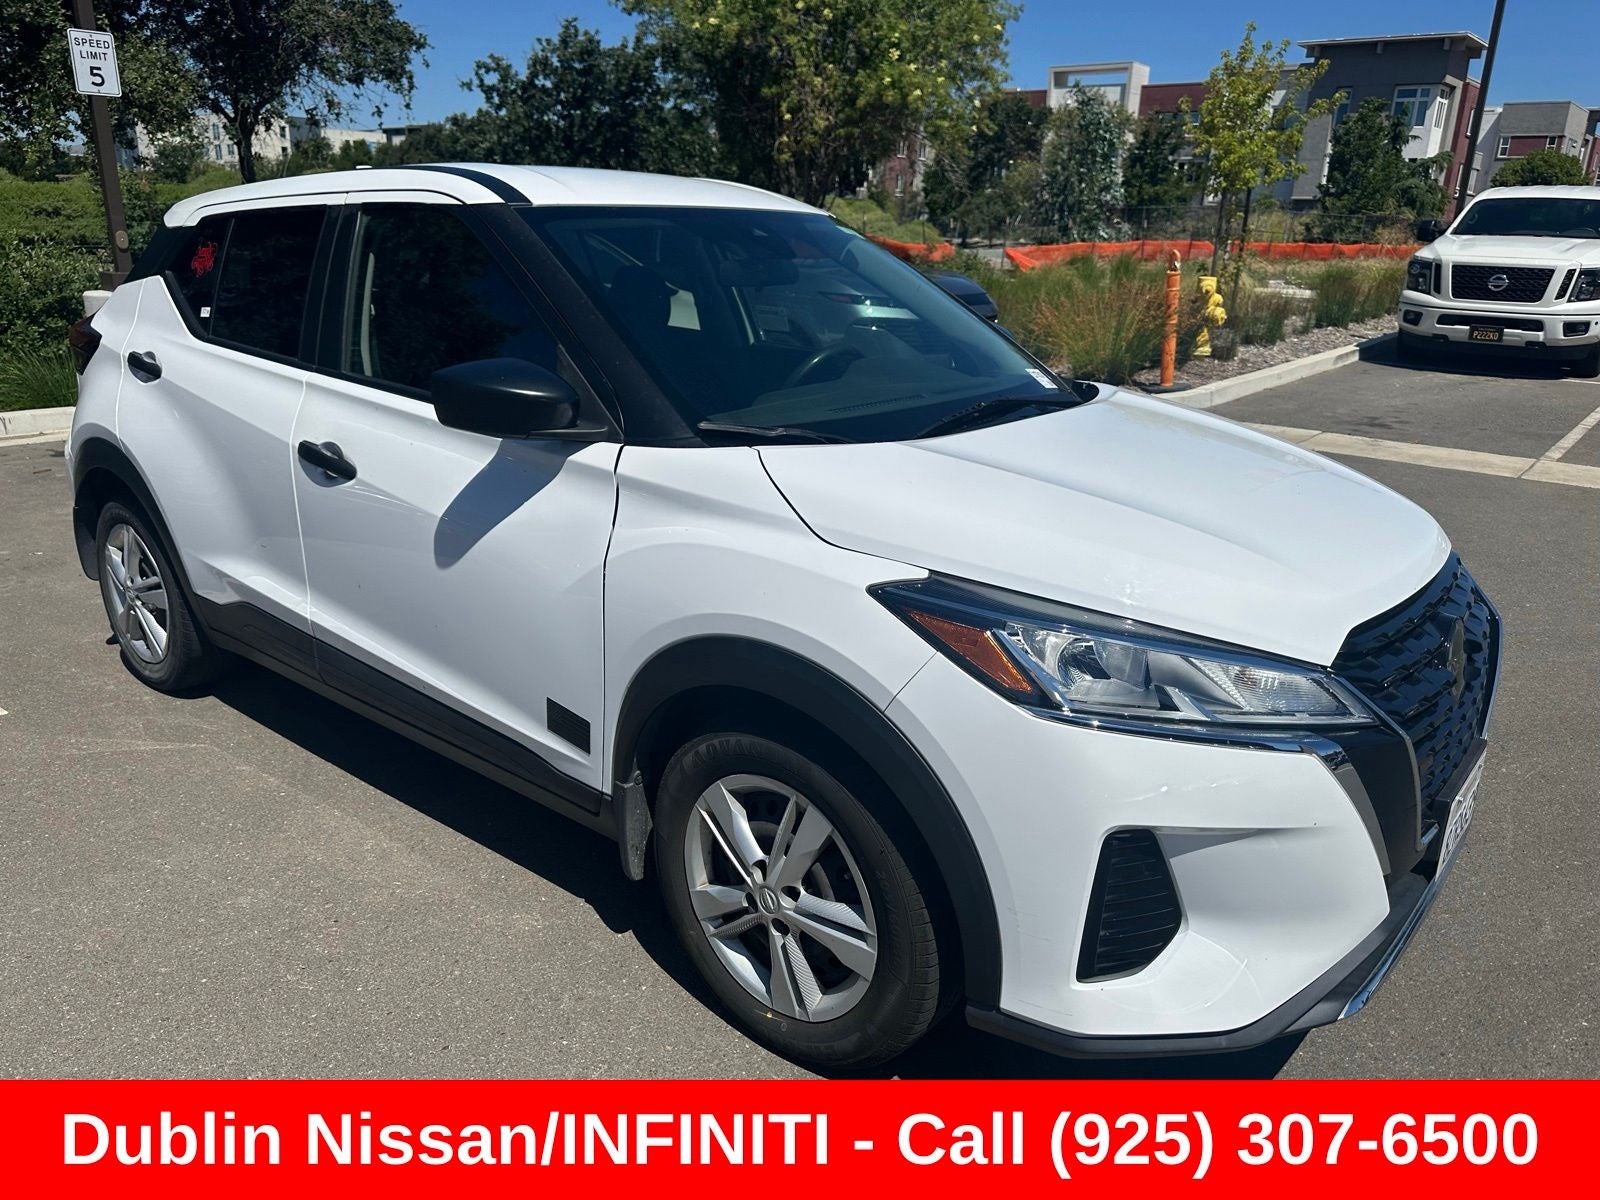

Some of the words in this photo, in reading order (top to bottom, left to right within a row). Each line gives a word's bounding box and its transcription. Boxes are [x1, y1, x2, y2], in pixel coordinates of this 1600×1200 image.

[73, 37, 110, 49] SPEED
[80, 50, 108, 61] LIMIT
[89, 65, 105, 87] 5
